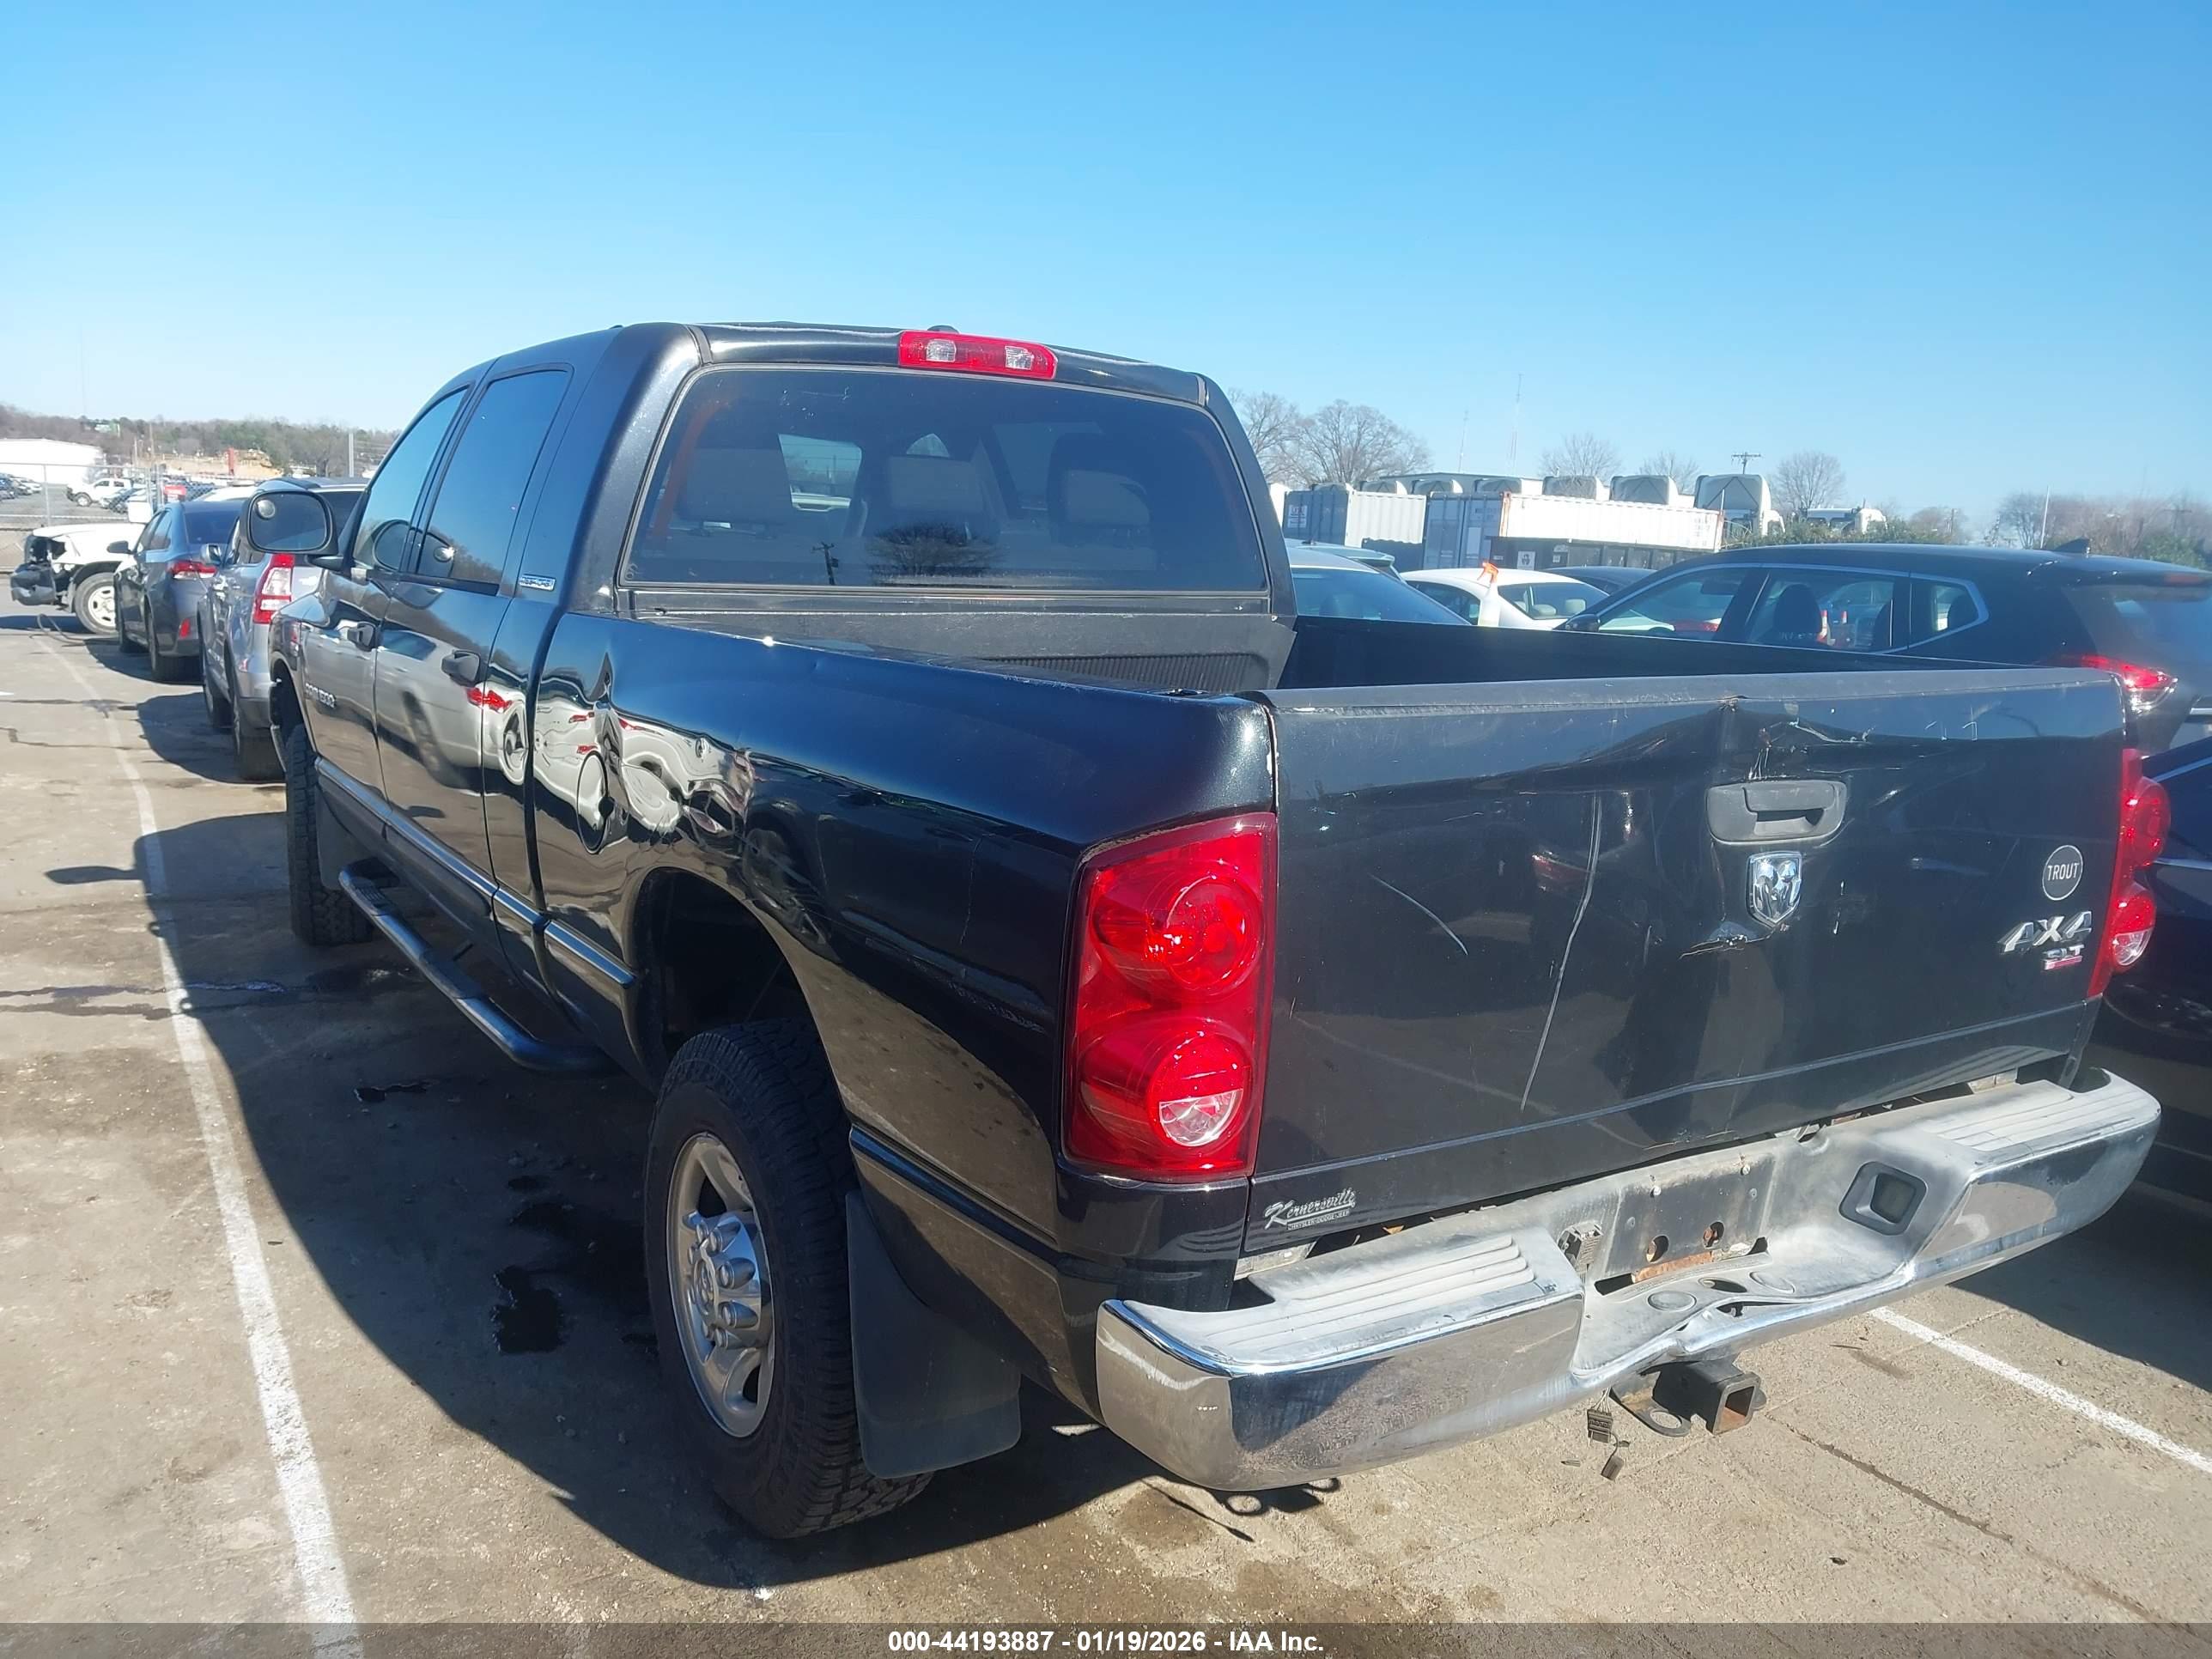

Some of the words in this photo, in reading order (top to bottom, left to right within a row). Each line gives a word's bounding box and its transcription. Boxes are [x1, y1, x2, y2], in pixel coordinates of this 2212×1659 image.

[2047, 862, 2080, 881] TROUT
[1998, 910, 2092, 952] 4X4
[1264, 1188, 1356, 1230] Kernersville
